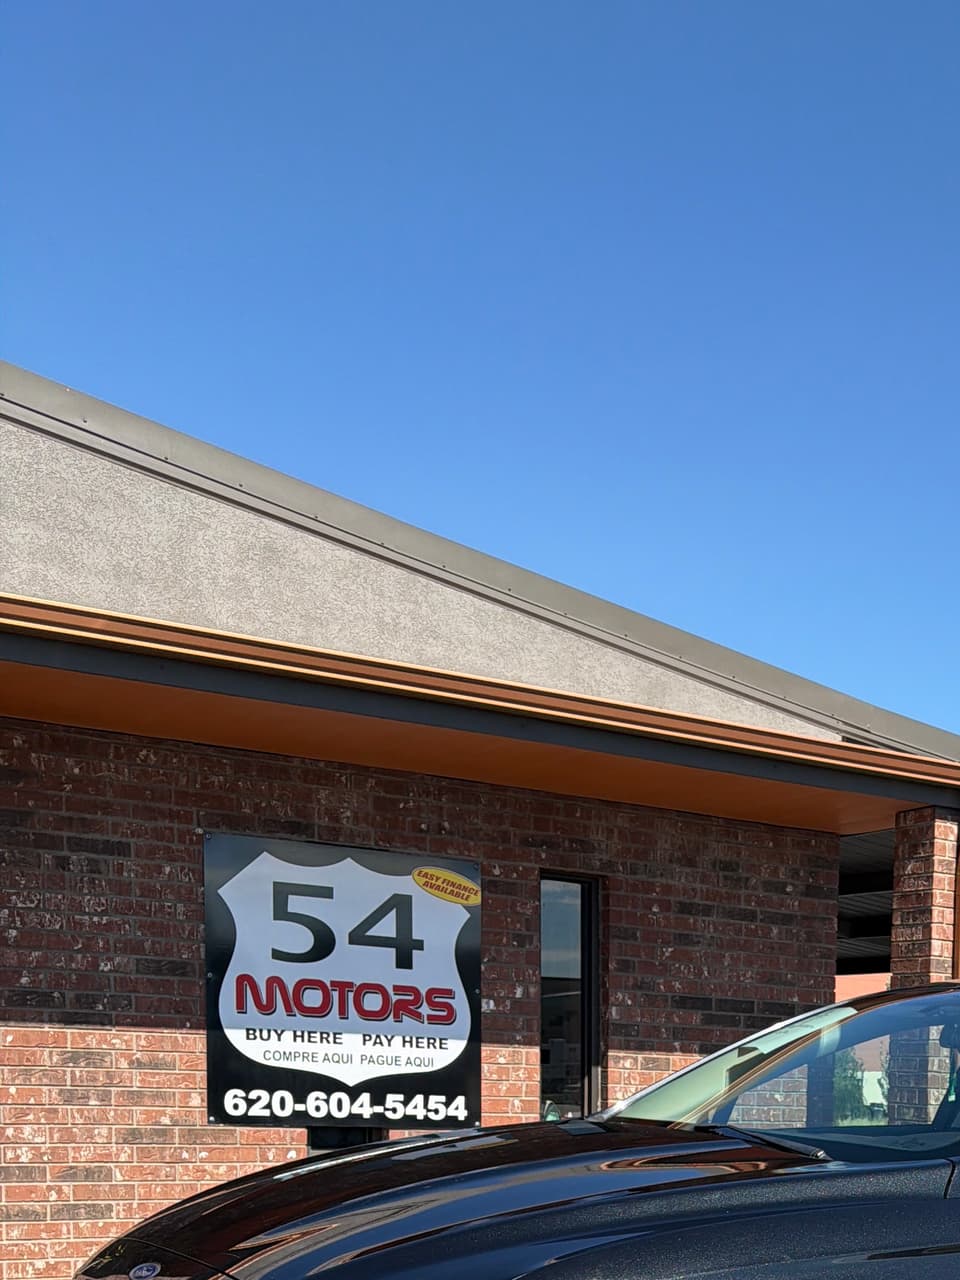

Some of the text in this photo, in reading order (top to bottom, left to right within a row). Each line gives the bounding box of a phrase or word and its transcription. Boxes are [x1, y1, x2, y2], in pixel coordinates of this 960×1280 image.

[416, 870, 480, 897] EASY FINANCE
[422, 880, 471, 901] AVAILABLE
[271, 881, 425, 970] 54
[235, 974, 456, 1025] MOTORS
[245, 1028, 449, 1050] BUY HERE PAY HERE
[263, 1050, 434, 1068] COMPRE AQUI PAGUE AQUI
[223, 1088, 468, 1121] 620-604-5454
